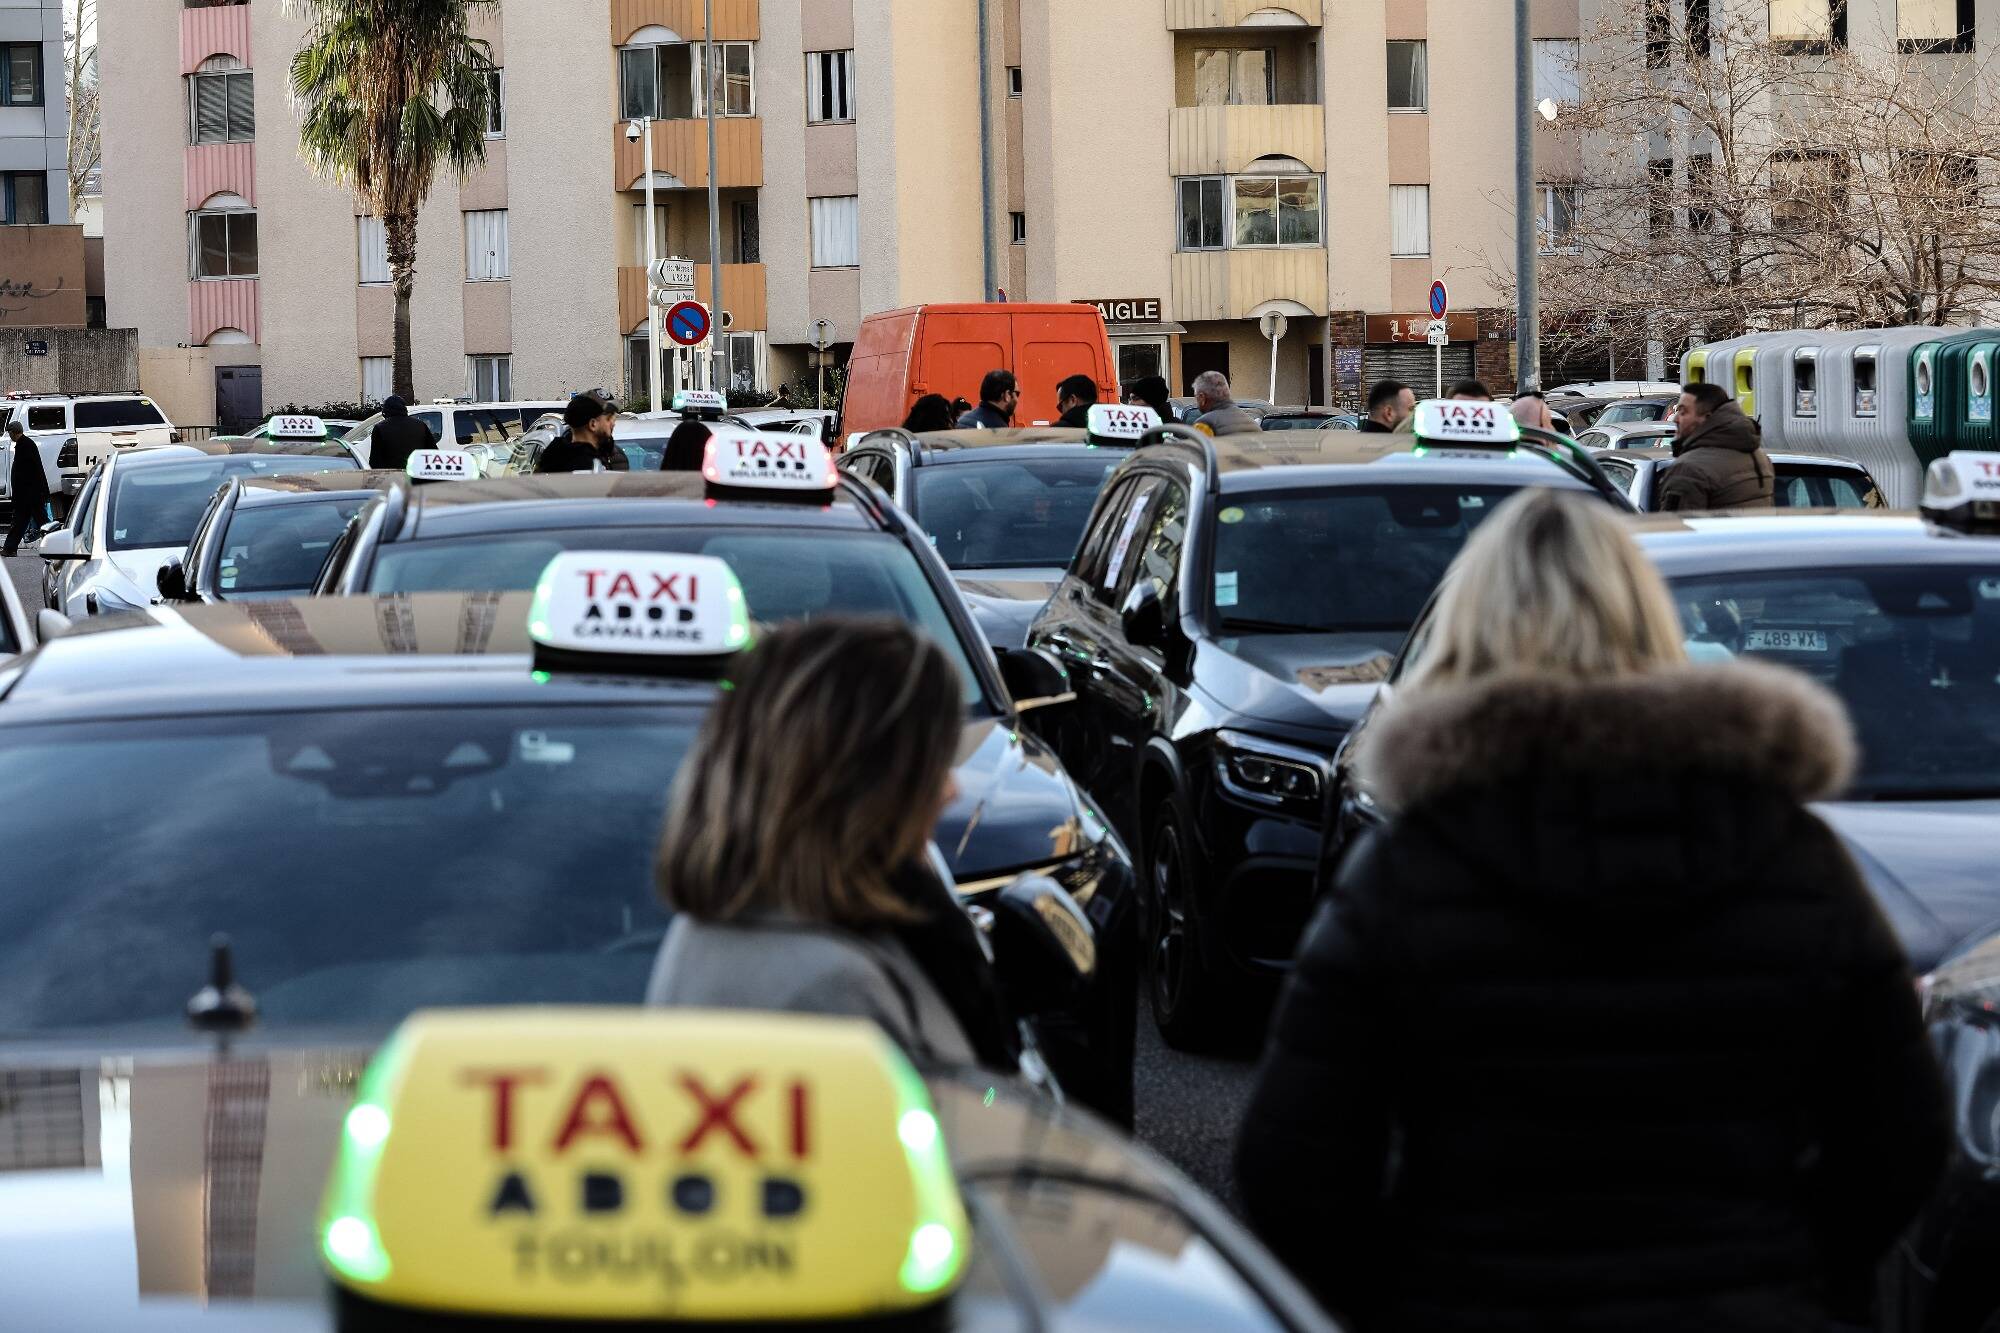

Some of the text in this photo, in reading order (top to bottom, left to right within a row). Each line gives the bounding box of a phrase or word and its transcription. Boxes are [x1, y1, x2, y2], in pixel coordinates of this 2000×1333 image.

[1104, 410, 1148, 422] TAXI
[1436, 406, 1495, 419] TAXI
[731, 440, 805, 459] TAXI
[421, 455, 462, 464] TAXI
[1974, 461, 2000, 477] T
[577, 570, 697, 602] TAXI
[574, 624, 703, 641] CAVALAIRE
[460, 1066, 813, 1160] TAXI
[515, 1232, 795, 1284] TOULON
